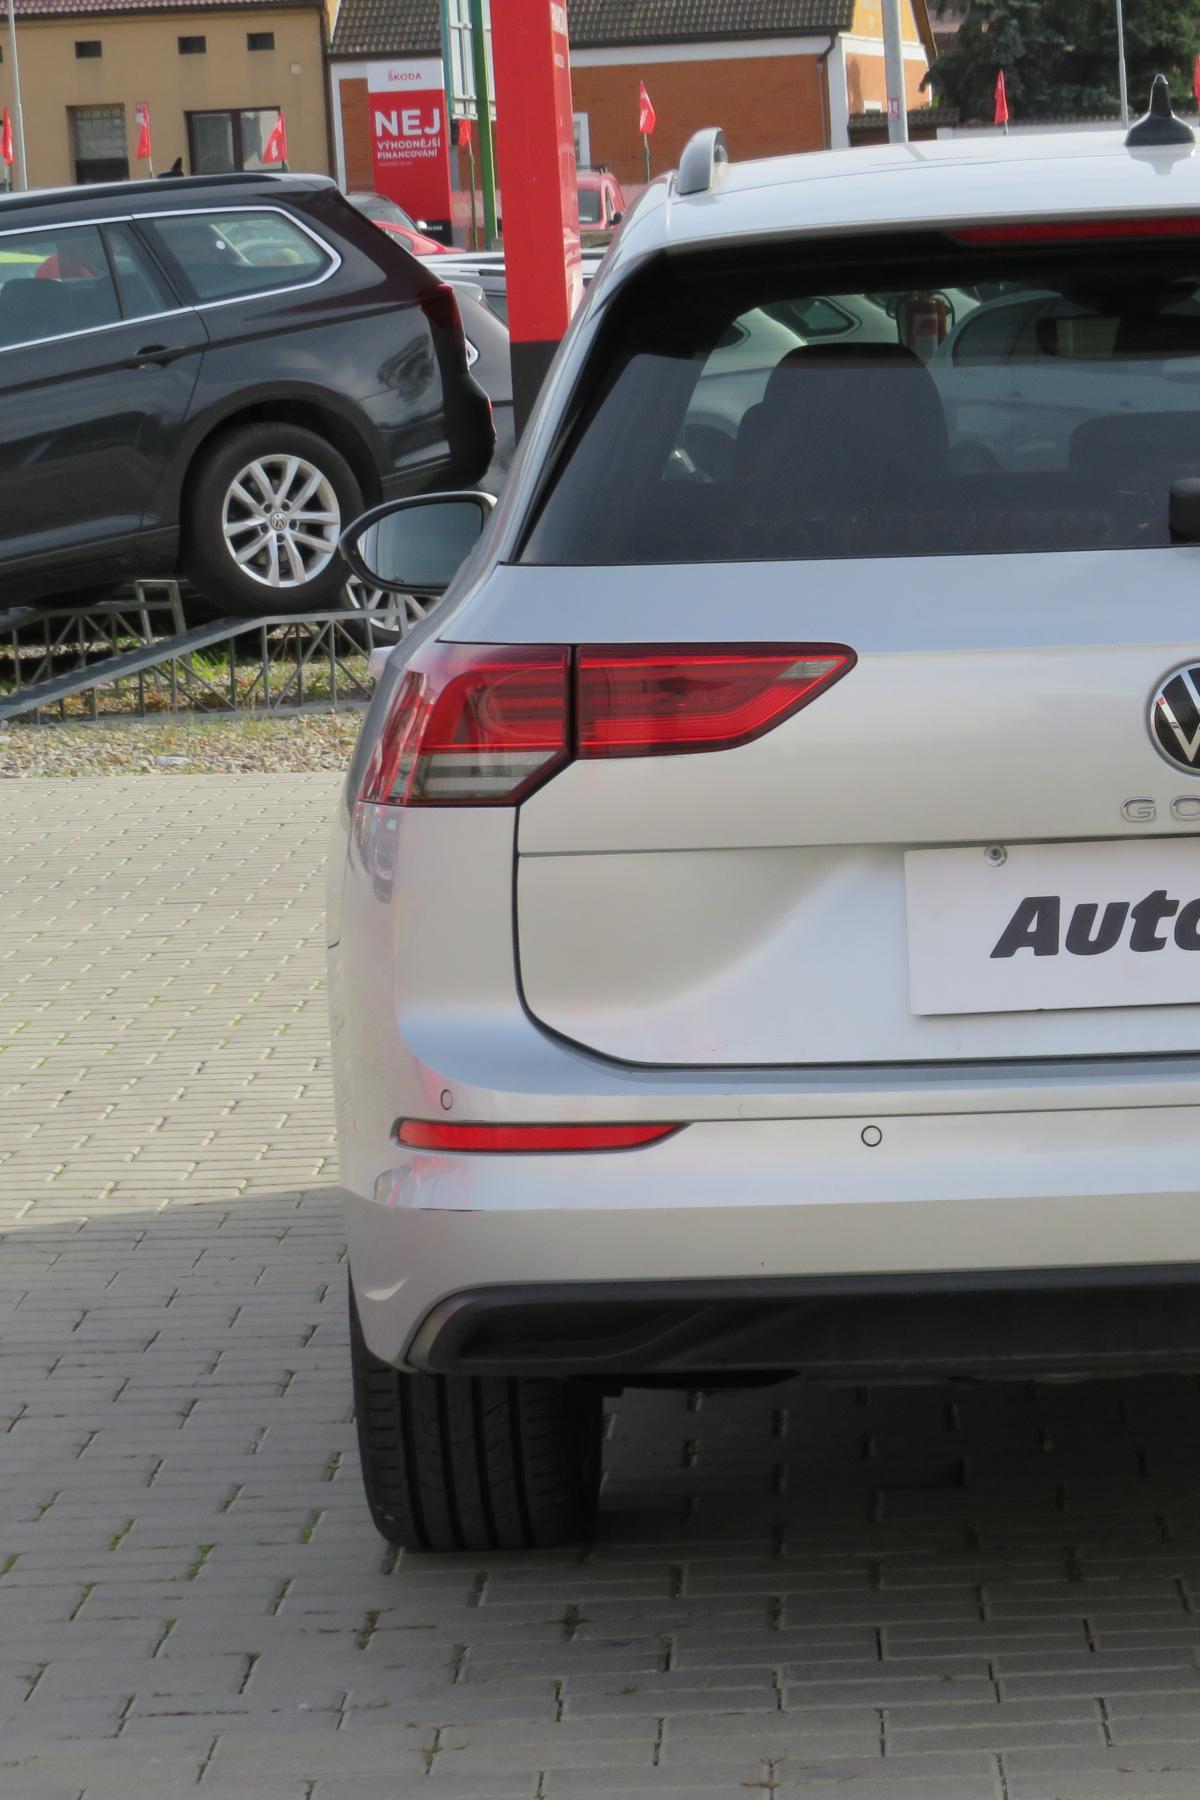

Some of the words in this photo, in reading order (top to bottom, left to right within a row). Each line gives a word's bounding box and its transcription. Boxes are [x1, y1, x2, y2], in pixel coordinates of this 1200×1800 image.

[387, 69, 422, 81] ŠKODA
[374, 108, 441, 137] NEJ
[377, 137, 441, 150] VÝHODNĚJŠÍ
[377, 148, 438, 160] FINANCOVÁNÍ
